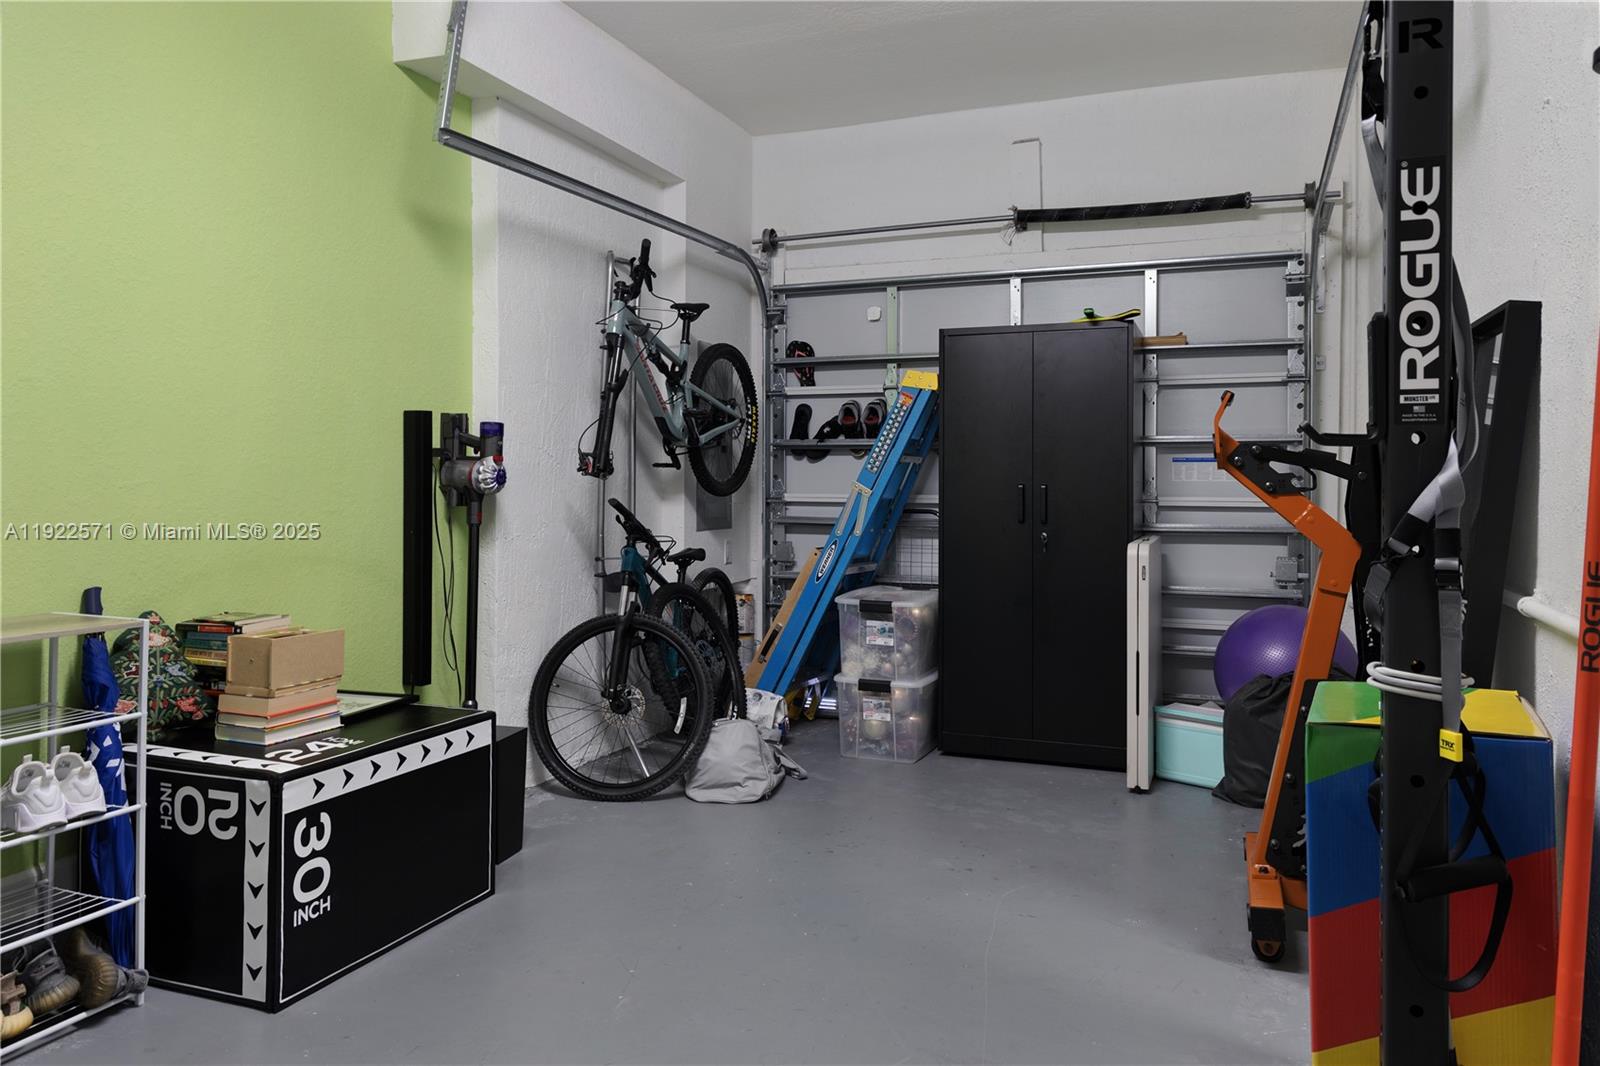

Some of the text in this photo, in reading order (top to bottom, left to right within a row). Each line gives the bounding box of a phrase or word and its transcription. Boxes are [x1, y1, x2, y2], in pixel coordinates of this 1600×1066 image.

[265, 741, 348, 762] 24
[160, 782, 172, 830] INCH
[174, 785, 239, 840] 20
[293, 812, 332, 903] 30
[293, 896, 331, 927] INCH
